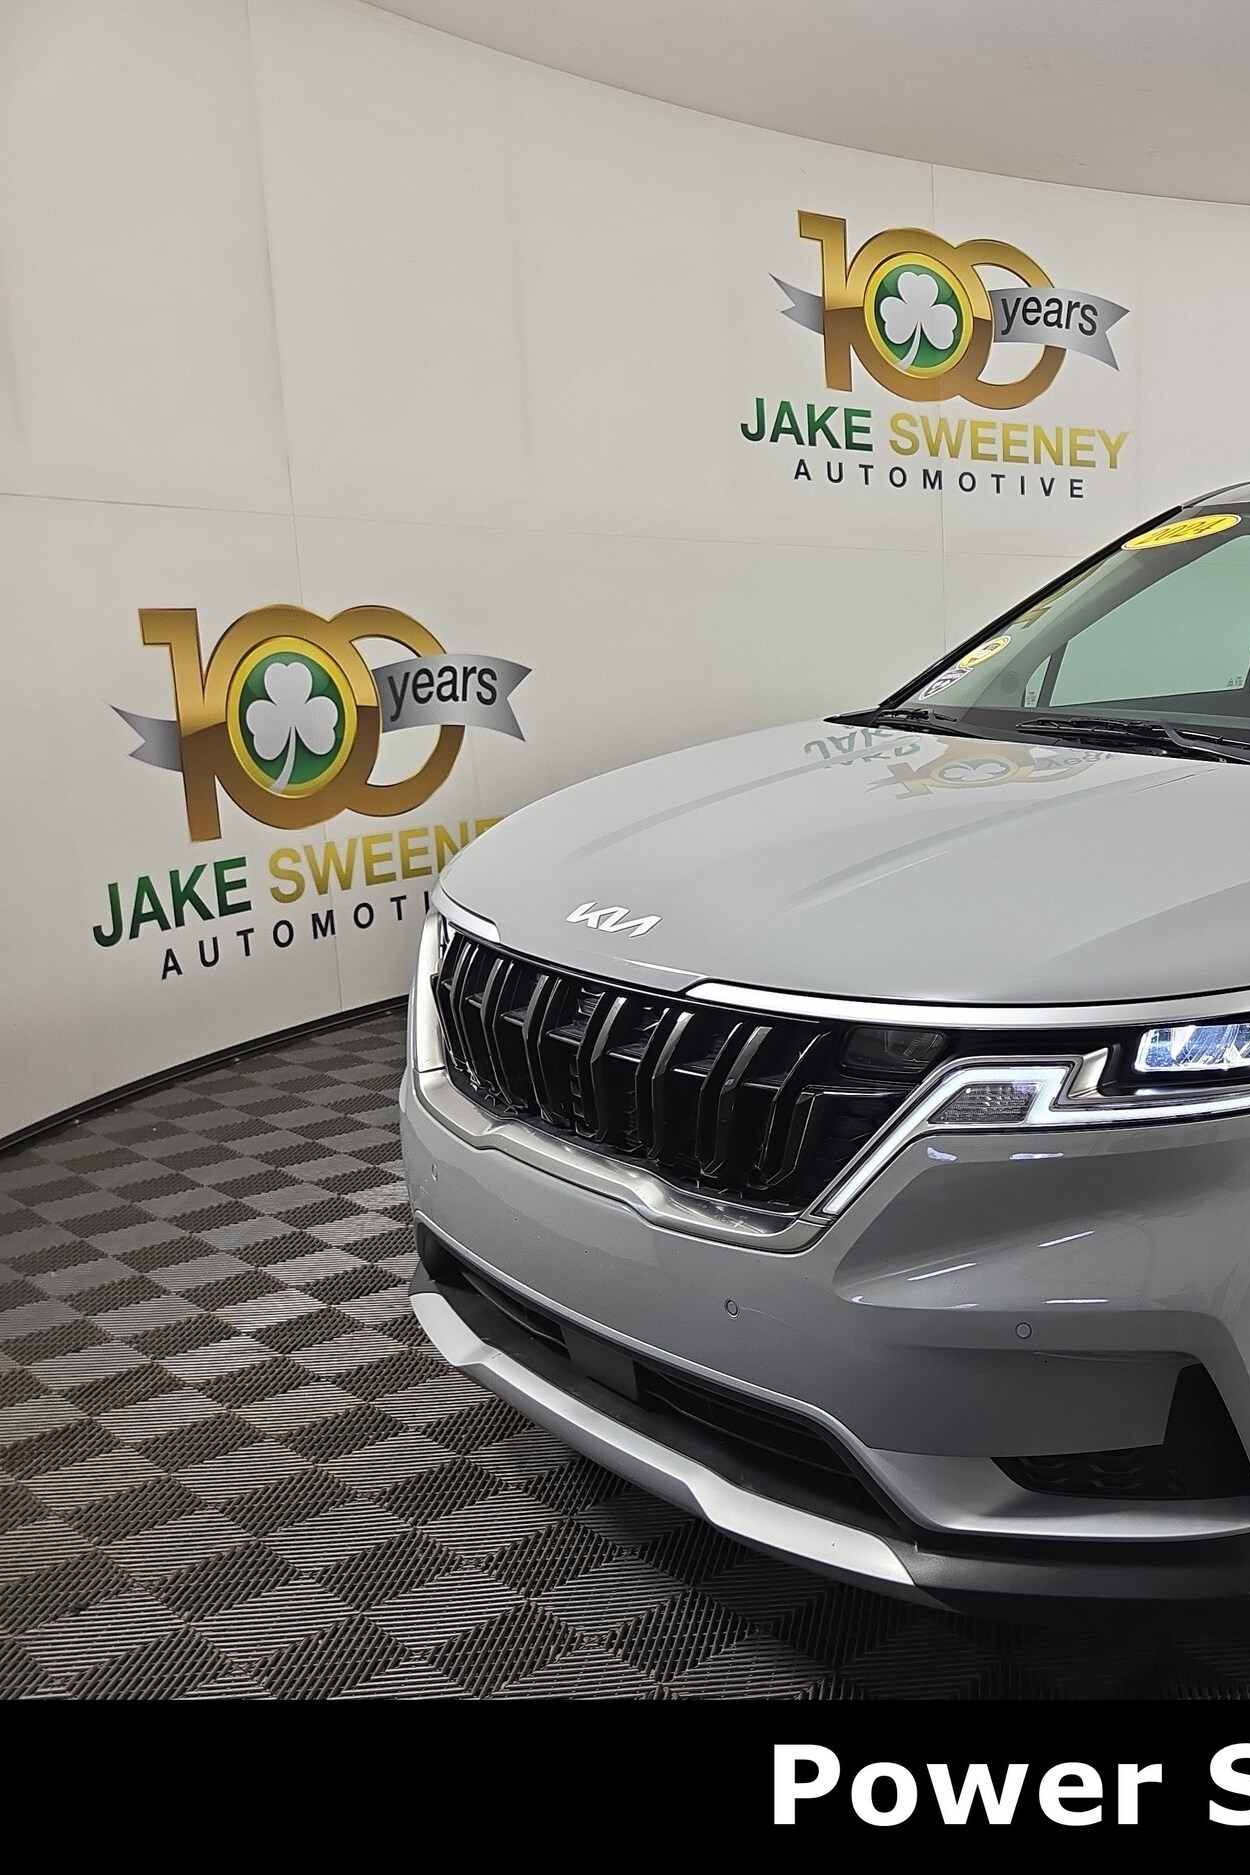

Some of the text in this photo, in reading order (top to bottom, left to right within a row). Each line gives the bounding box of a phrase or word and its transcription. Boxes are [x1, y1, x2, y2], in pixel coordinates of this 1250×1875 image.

[1001, 296, 1098, 336] years
[740, 397, 1129, 469] JAKE SWEENEY
[794, 459, 1085, 498] AUTOMOTIVE
[1132, 517, 1229, 546] 2024
[386, 665, 497, 721] years
[93, 817, 505, 947] JAKE SWEEN
[161, 890, 430, 980] AUTOMOTI
[565, 901, 663, 939] KIA
